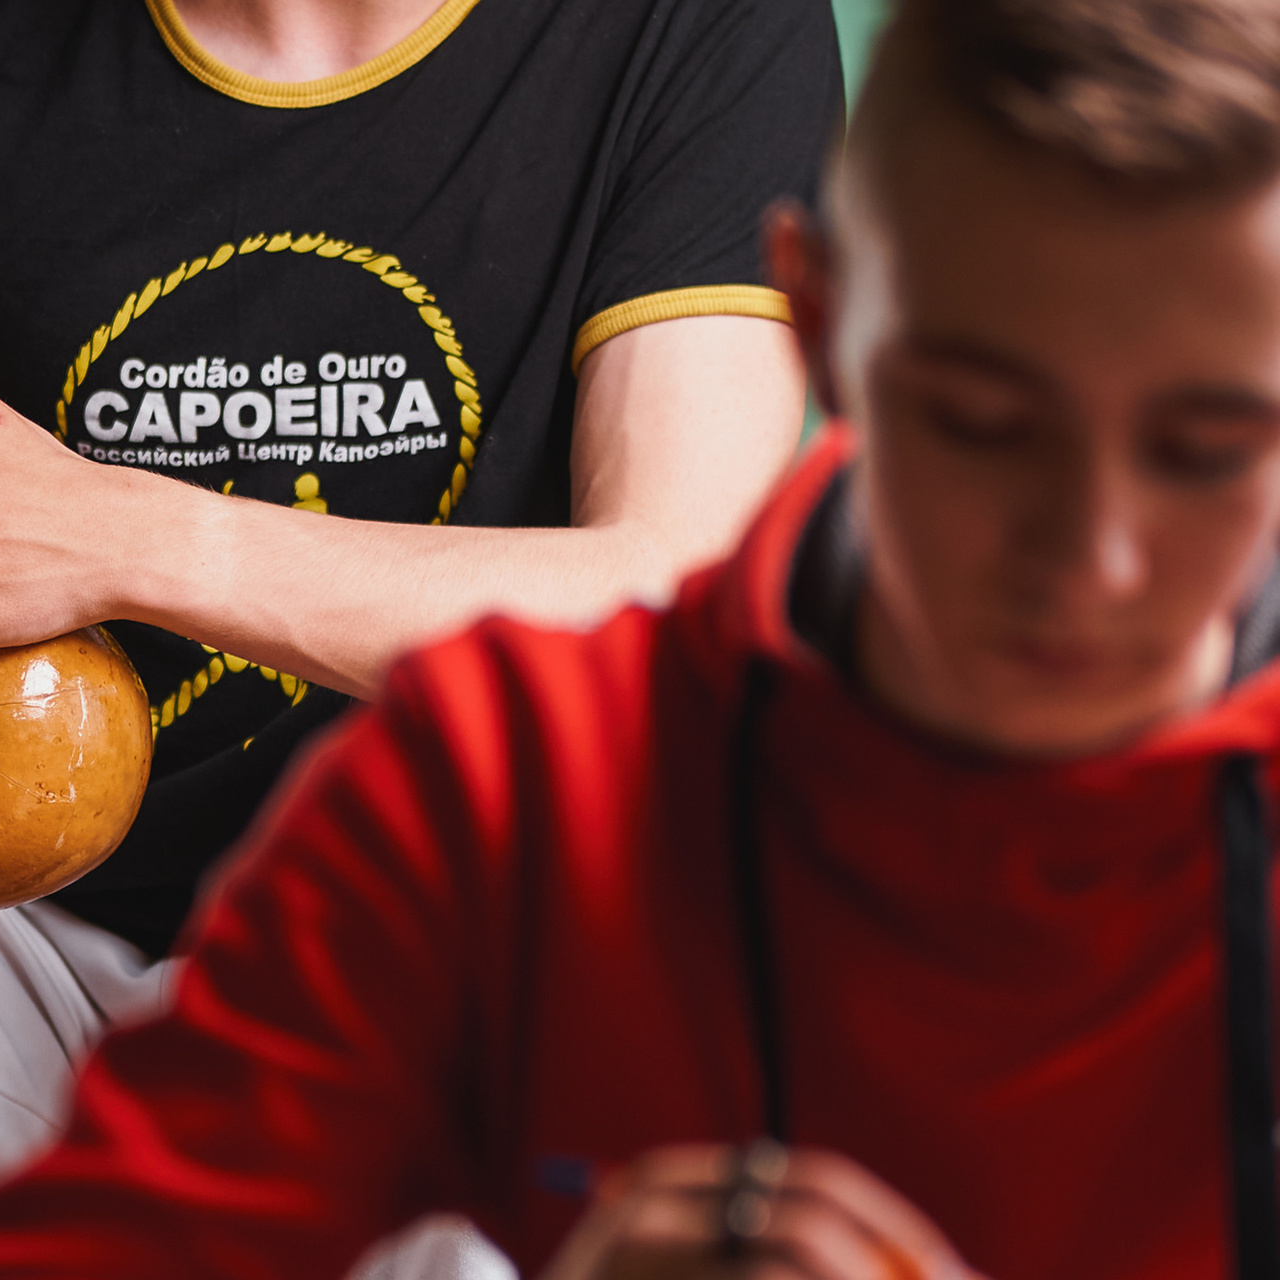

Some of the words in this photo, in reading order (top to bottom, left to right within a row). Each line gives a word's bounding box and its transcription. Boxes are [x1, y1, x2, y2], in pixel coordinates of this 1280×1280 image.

[120, 355, 250, 389] Cordão
[260, 354, 308, 387] de
[319, 352, 407, 382] Ouro
[84, 379, 441, 444] CAPOEIRA
[76, 441, 230, 467] Российский
[238, 442, 313, 466] Центр
[319, 431, 447, 462] Капоэйры
